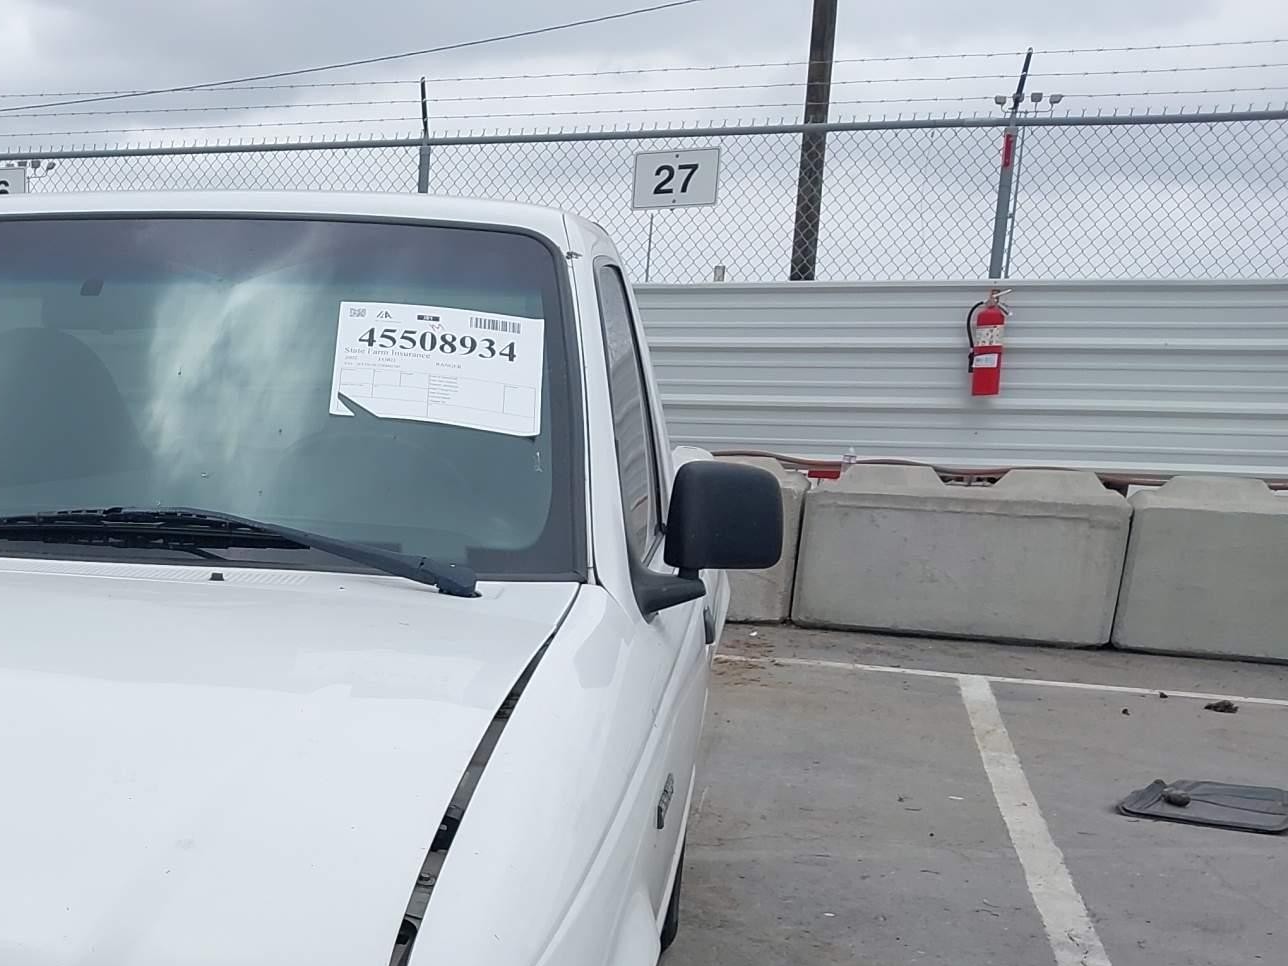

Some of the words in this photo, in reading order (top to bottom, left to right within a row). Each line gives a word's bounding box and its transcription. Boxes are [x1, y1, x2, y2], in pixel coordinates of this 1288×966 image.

[653, 163, 699, 195] 27
[344, 346, 366, 354] State
[367, 347, 390, 356] Farm
[391, 349, 431, 359] Insurance
[358, 327, 516, 363] 45508934
